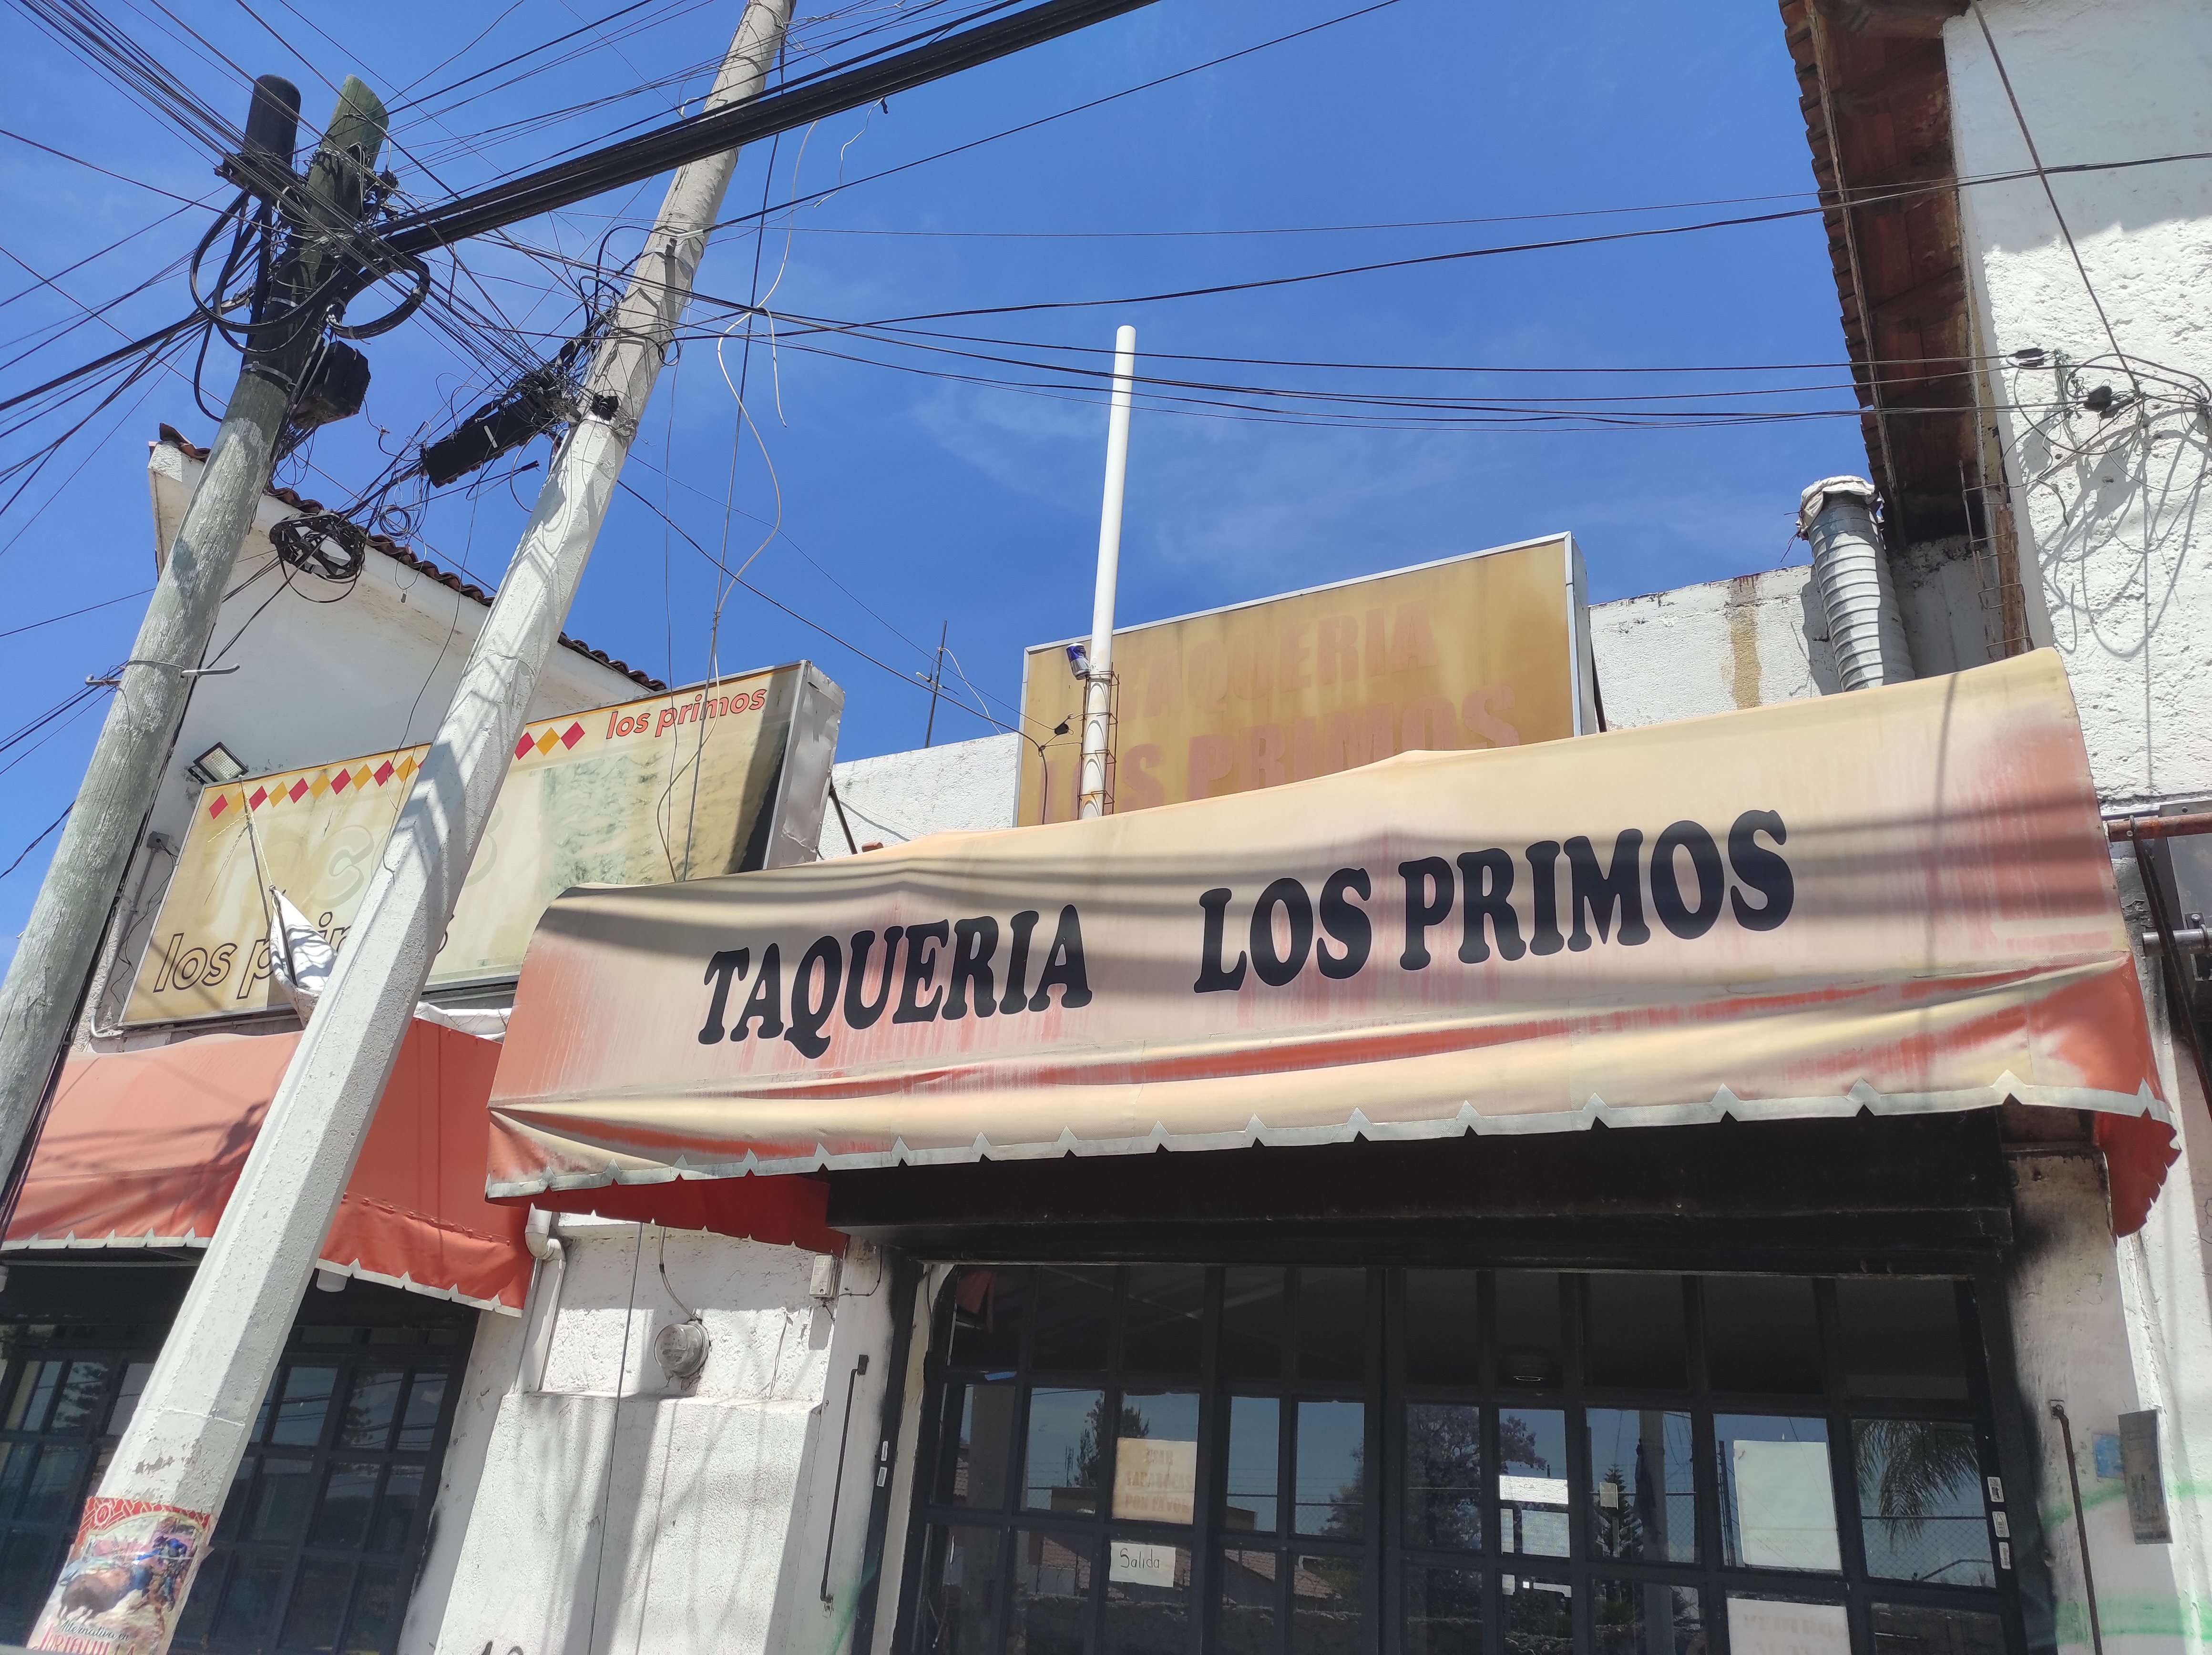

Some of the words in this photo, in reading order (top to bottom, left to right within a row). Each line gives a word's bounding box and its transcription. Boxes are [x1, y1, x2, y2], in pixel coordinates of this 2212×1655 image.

[606, 711, 651, 740] los
[655, 689, 768, 738] primos
[698, 904, 1093, 1060] TAQUERIA
[1193, 867, 1372, 993] LOS
[1398, 809, 1795, 971] PRIMOS
[153, 932, 238, 993] los
[1120, 1548, 1160, 1569] Salida
[57, 1618, 117, 1641] Alternativa
[118, 1633, 130, 1642] en
